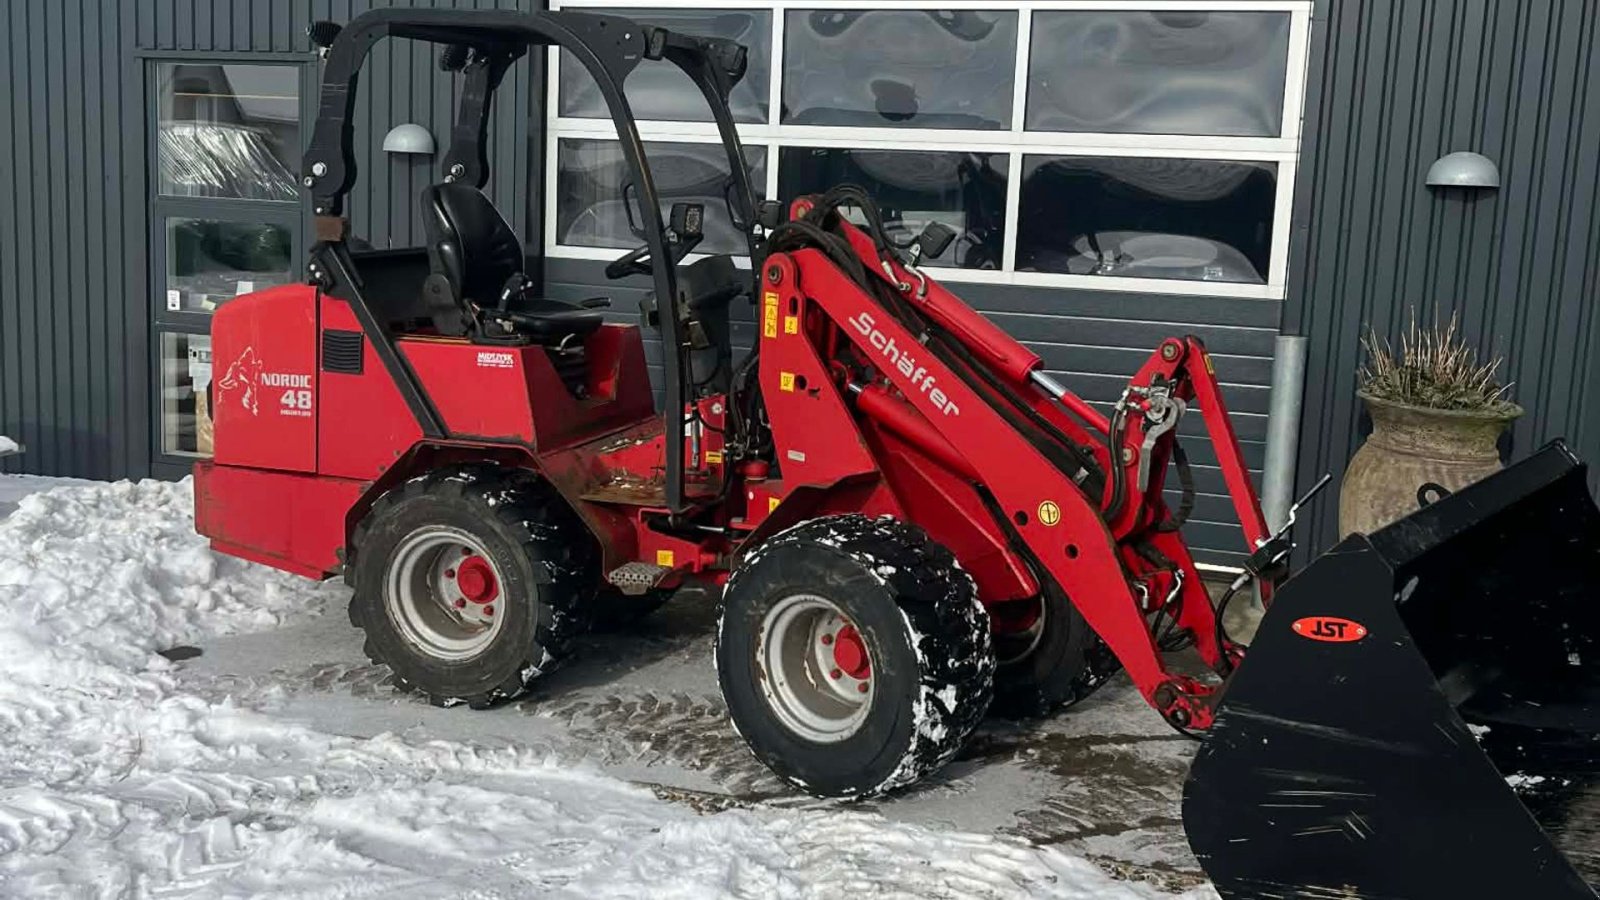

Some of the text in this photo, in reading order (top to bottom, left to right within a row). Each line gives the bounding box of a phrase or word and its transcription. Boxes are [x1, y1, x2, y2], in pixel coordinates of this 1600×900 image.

[849, 312, 960, 416] Schäffer
[261, 373, 312, 388] NORDIC
[280, 390, 312, 409] 48
[1310, 620, 1349, 638] JST
